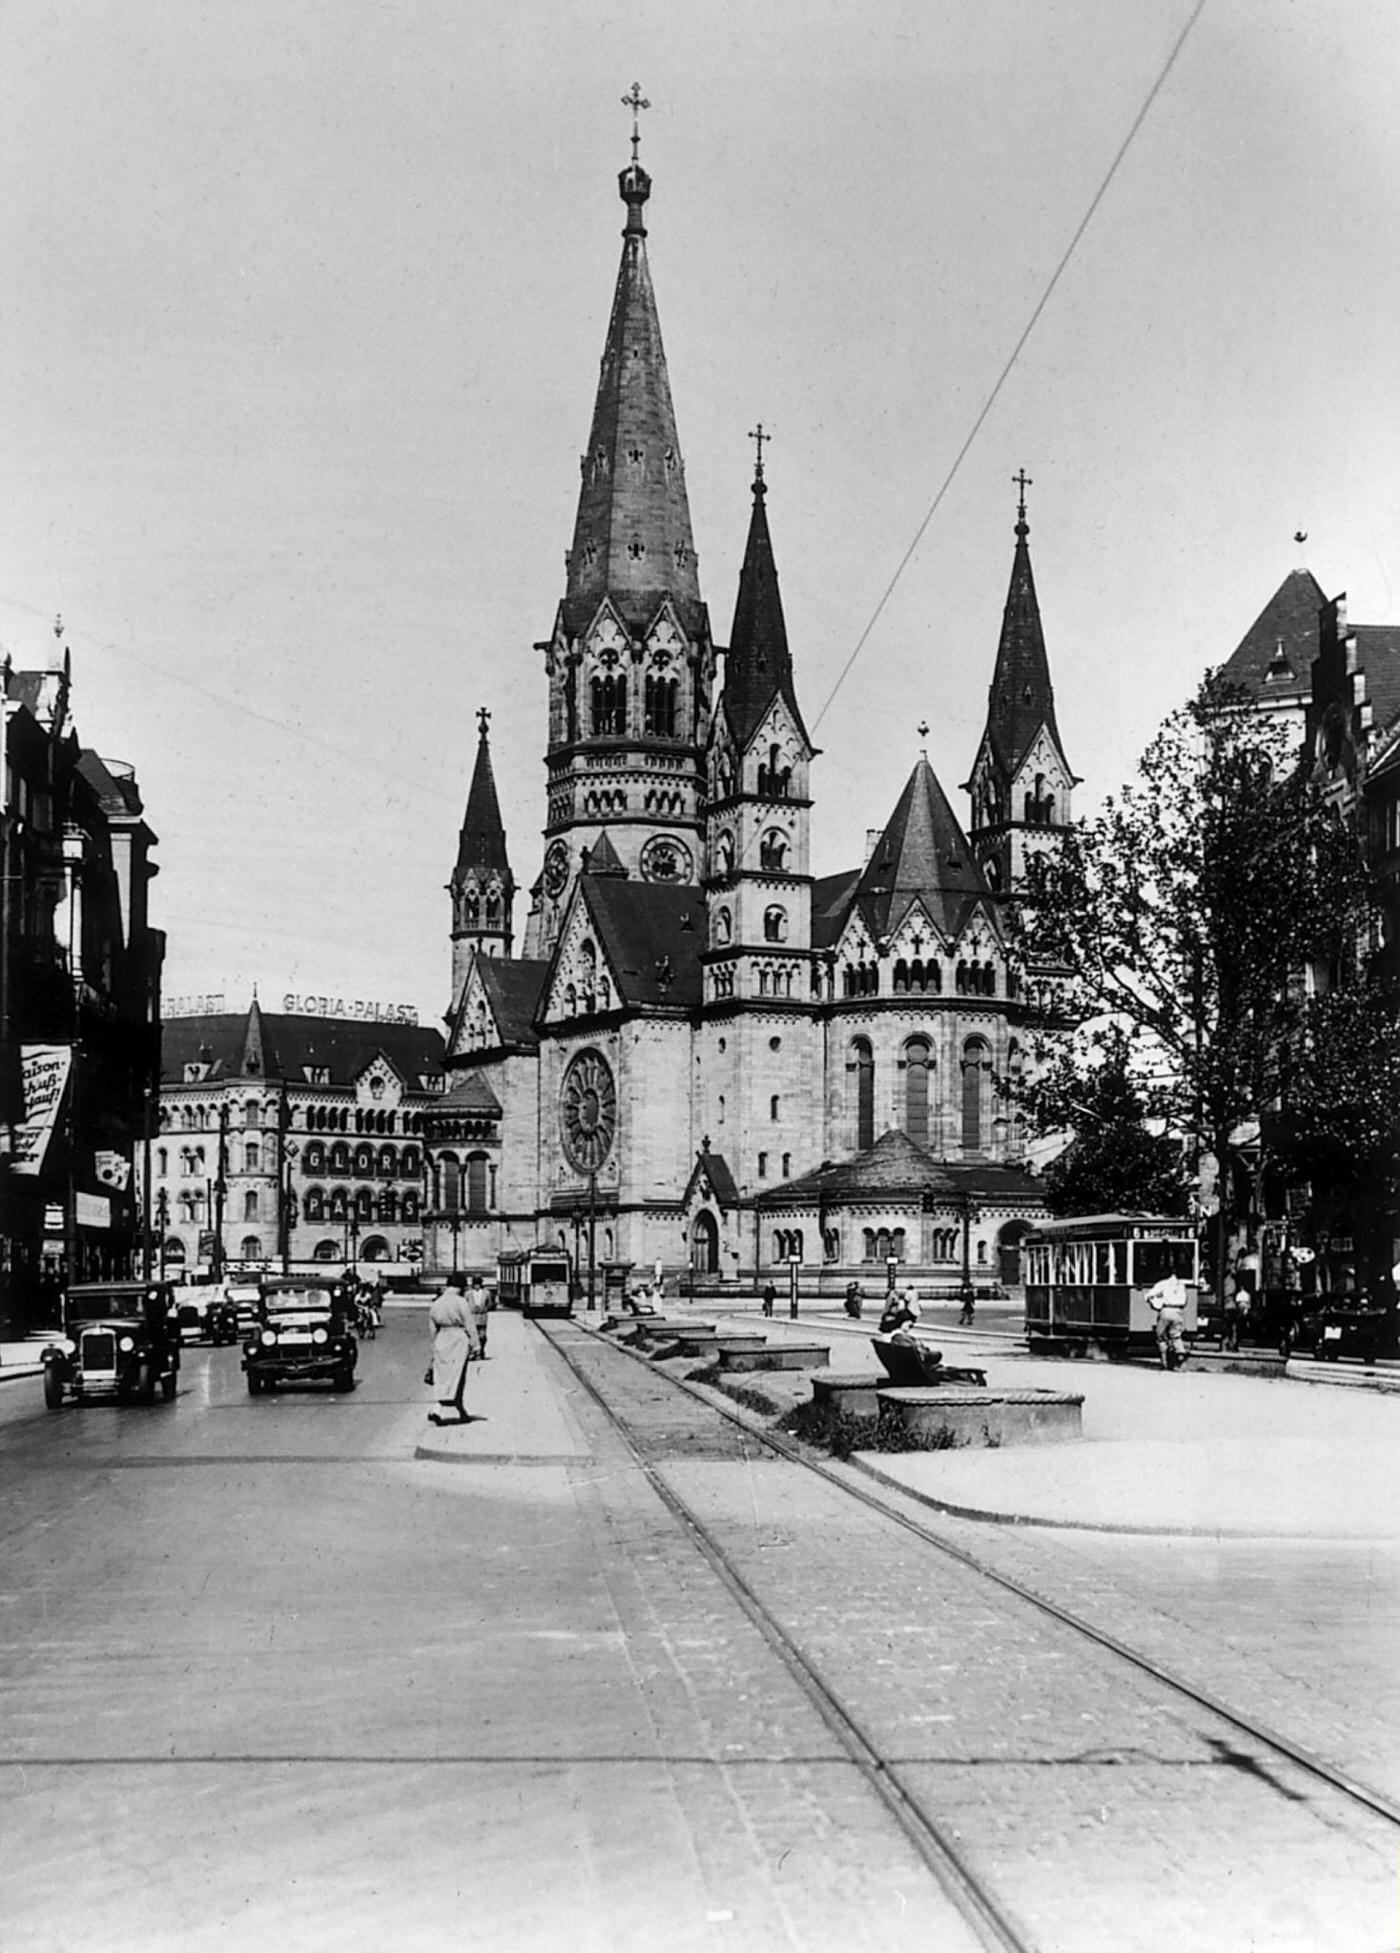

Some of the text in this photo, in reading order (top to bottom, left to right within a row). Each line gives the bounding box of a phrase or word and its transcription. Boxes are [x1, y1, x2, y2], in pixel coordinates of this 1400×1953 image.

[22, 1060, 65, 1079] aison-
[1133, 1226, 1141, 1239] 6
[1188, 1226, 1195, 1239] 6
